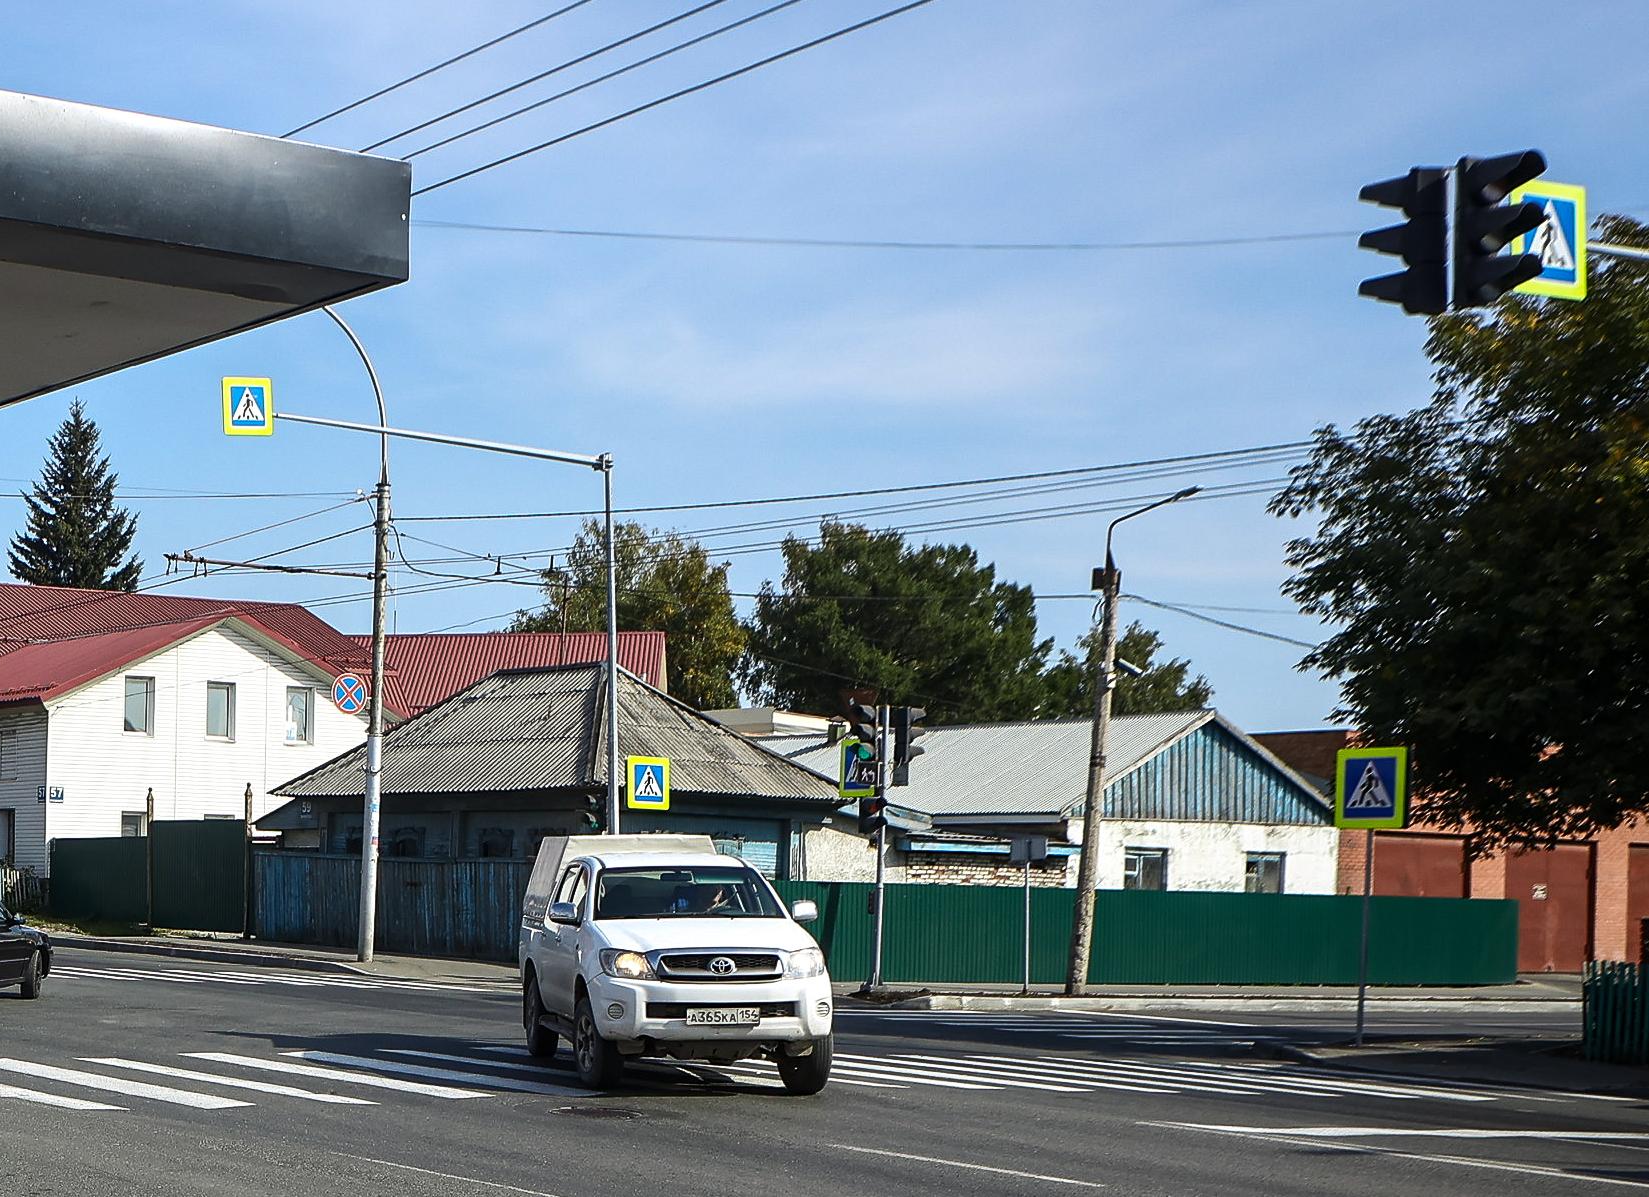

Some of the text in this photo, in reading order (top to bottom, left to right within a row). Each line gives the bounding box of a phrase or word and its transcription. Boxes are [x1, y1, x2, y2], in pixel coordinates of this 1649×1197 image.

[51, 787, 63, 798] 57
[302, 801, 312, 813] 59
[690, 1010, 758, 1023] А365КА 154
